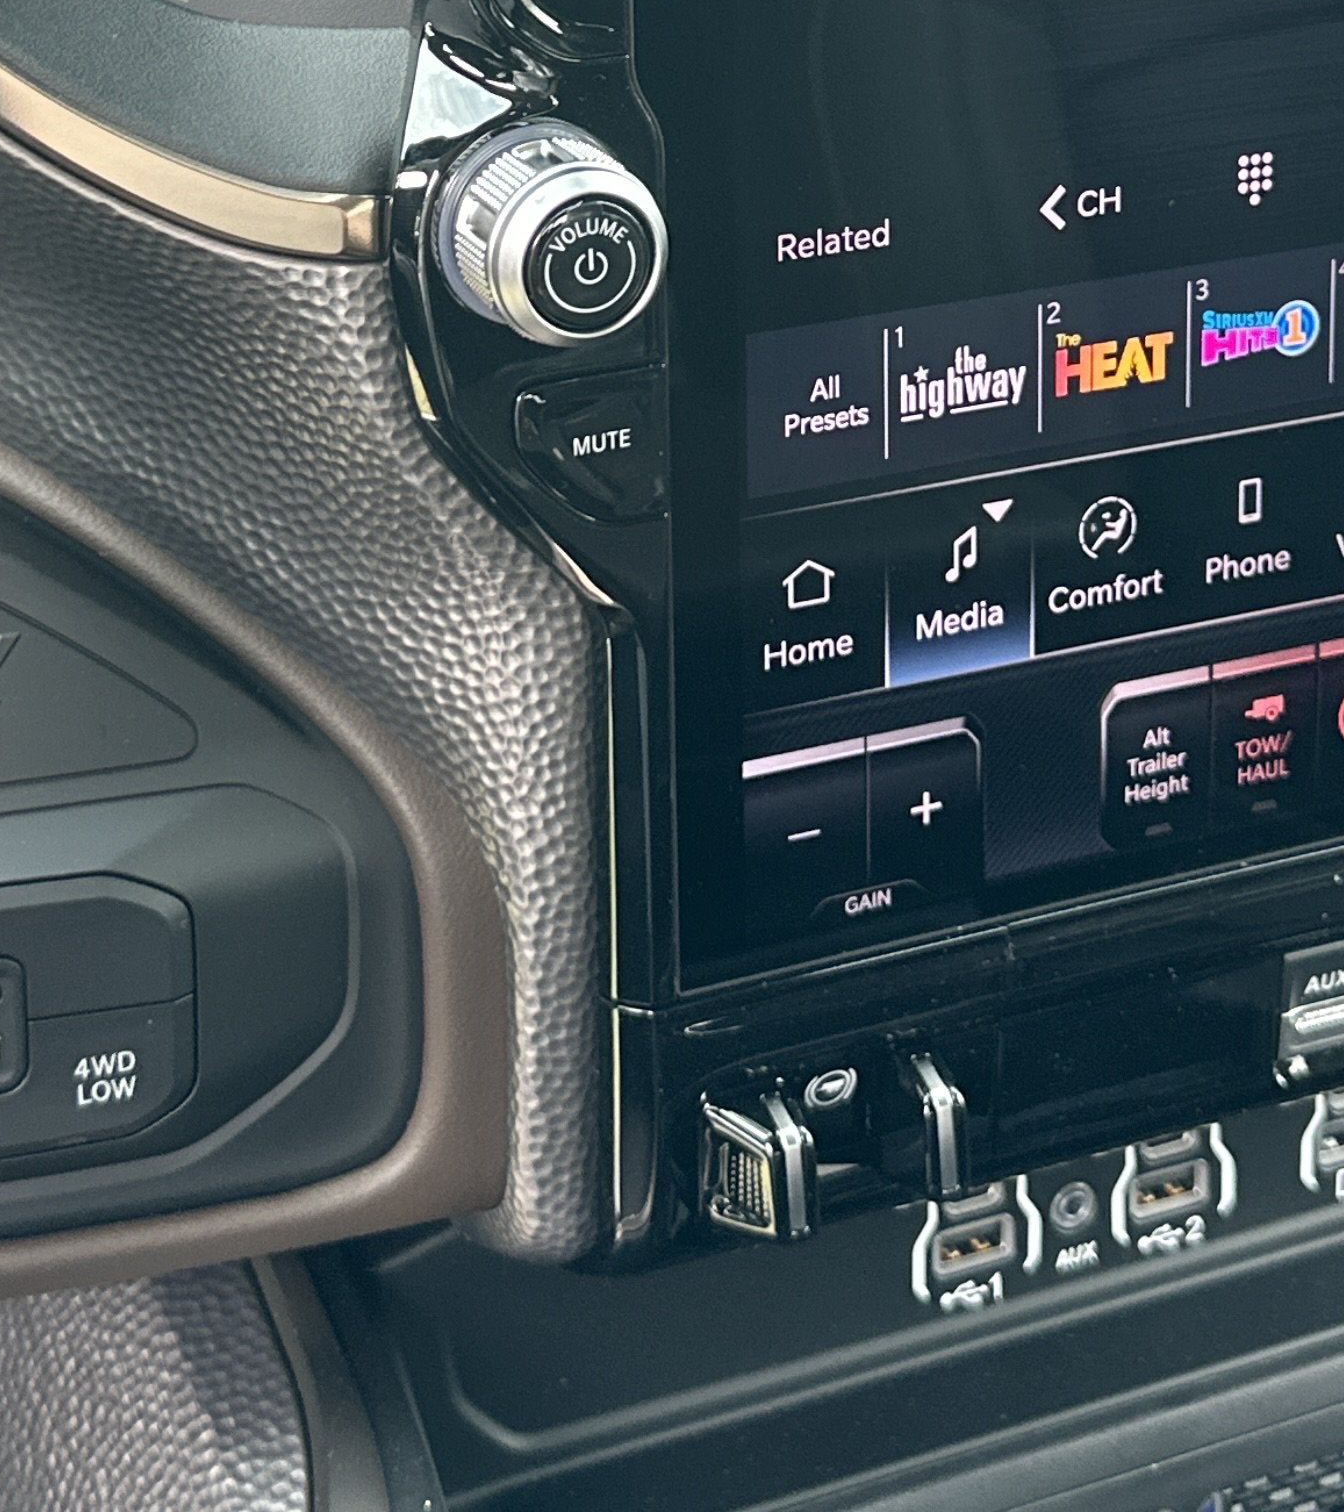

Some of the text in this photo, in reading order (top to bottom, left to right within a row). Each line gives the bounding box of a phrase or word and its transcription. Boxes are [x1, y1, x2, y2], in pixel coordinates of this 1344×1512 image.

[1077, 186, 1122, 218] CH
[548, 217, 629, 253] VOLUME
[777, 218, 891, 262] Related
[1194, 278, 1210, 301] 3
[1046, 302, 1061, 324] 2
[894, 326, 904, 348] 1
[955, 345, 987, 373] the
[1054, 330, 1174, 397] HEAT
[810, 375, 841, 402] All
[899, 365, 1027, 419] highway
[784, 405, 870, 438] Presets
[572, 428, 631, 456] MUTE
[1205, 550, 1290, 584] Phone
[1048, 569, 1163, 614] Comfort
[916, 601, 1004, 641] Media
[764, 635, 854, 670] Home
[1143, 727, 1171, 749] Alt
[1235, 731, 1291, 759] TOW/
[1127, 751, 1186, 778] Trailer
[1237, 759, 1288, 785] HAUL
[1124, 775, 1189, 805] Height
[844, 889, 892, 916] GAIN
[73, 1050, 136, 1079] 4WD
[76, 1076, 137, 1106] LOW
[1185, 1214, 1206, 1245] 2
[1055, 1240, 1099, 1273] AUX
[988, 1271, 1004, 1302] 1
